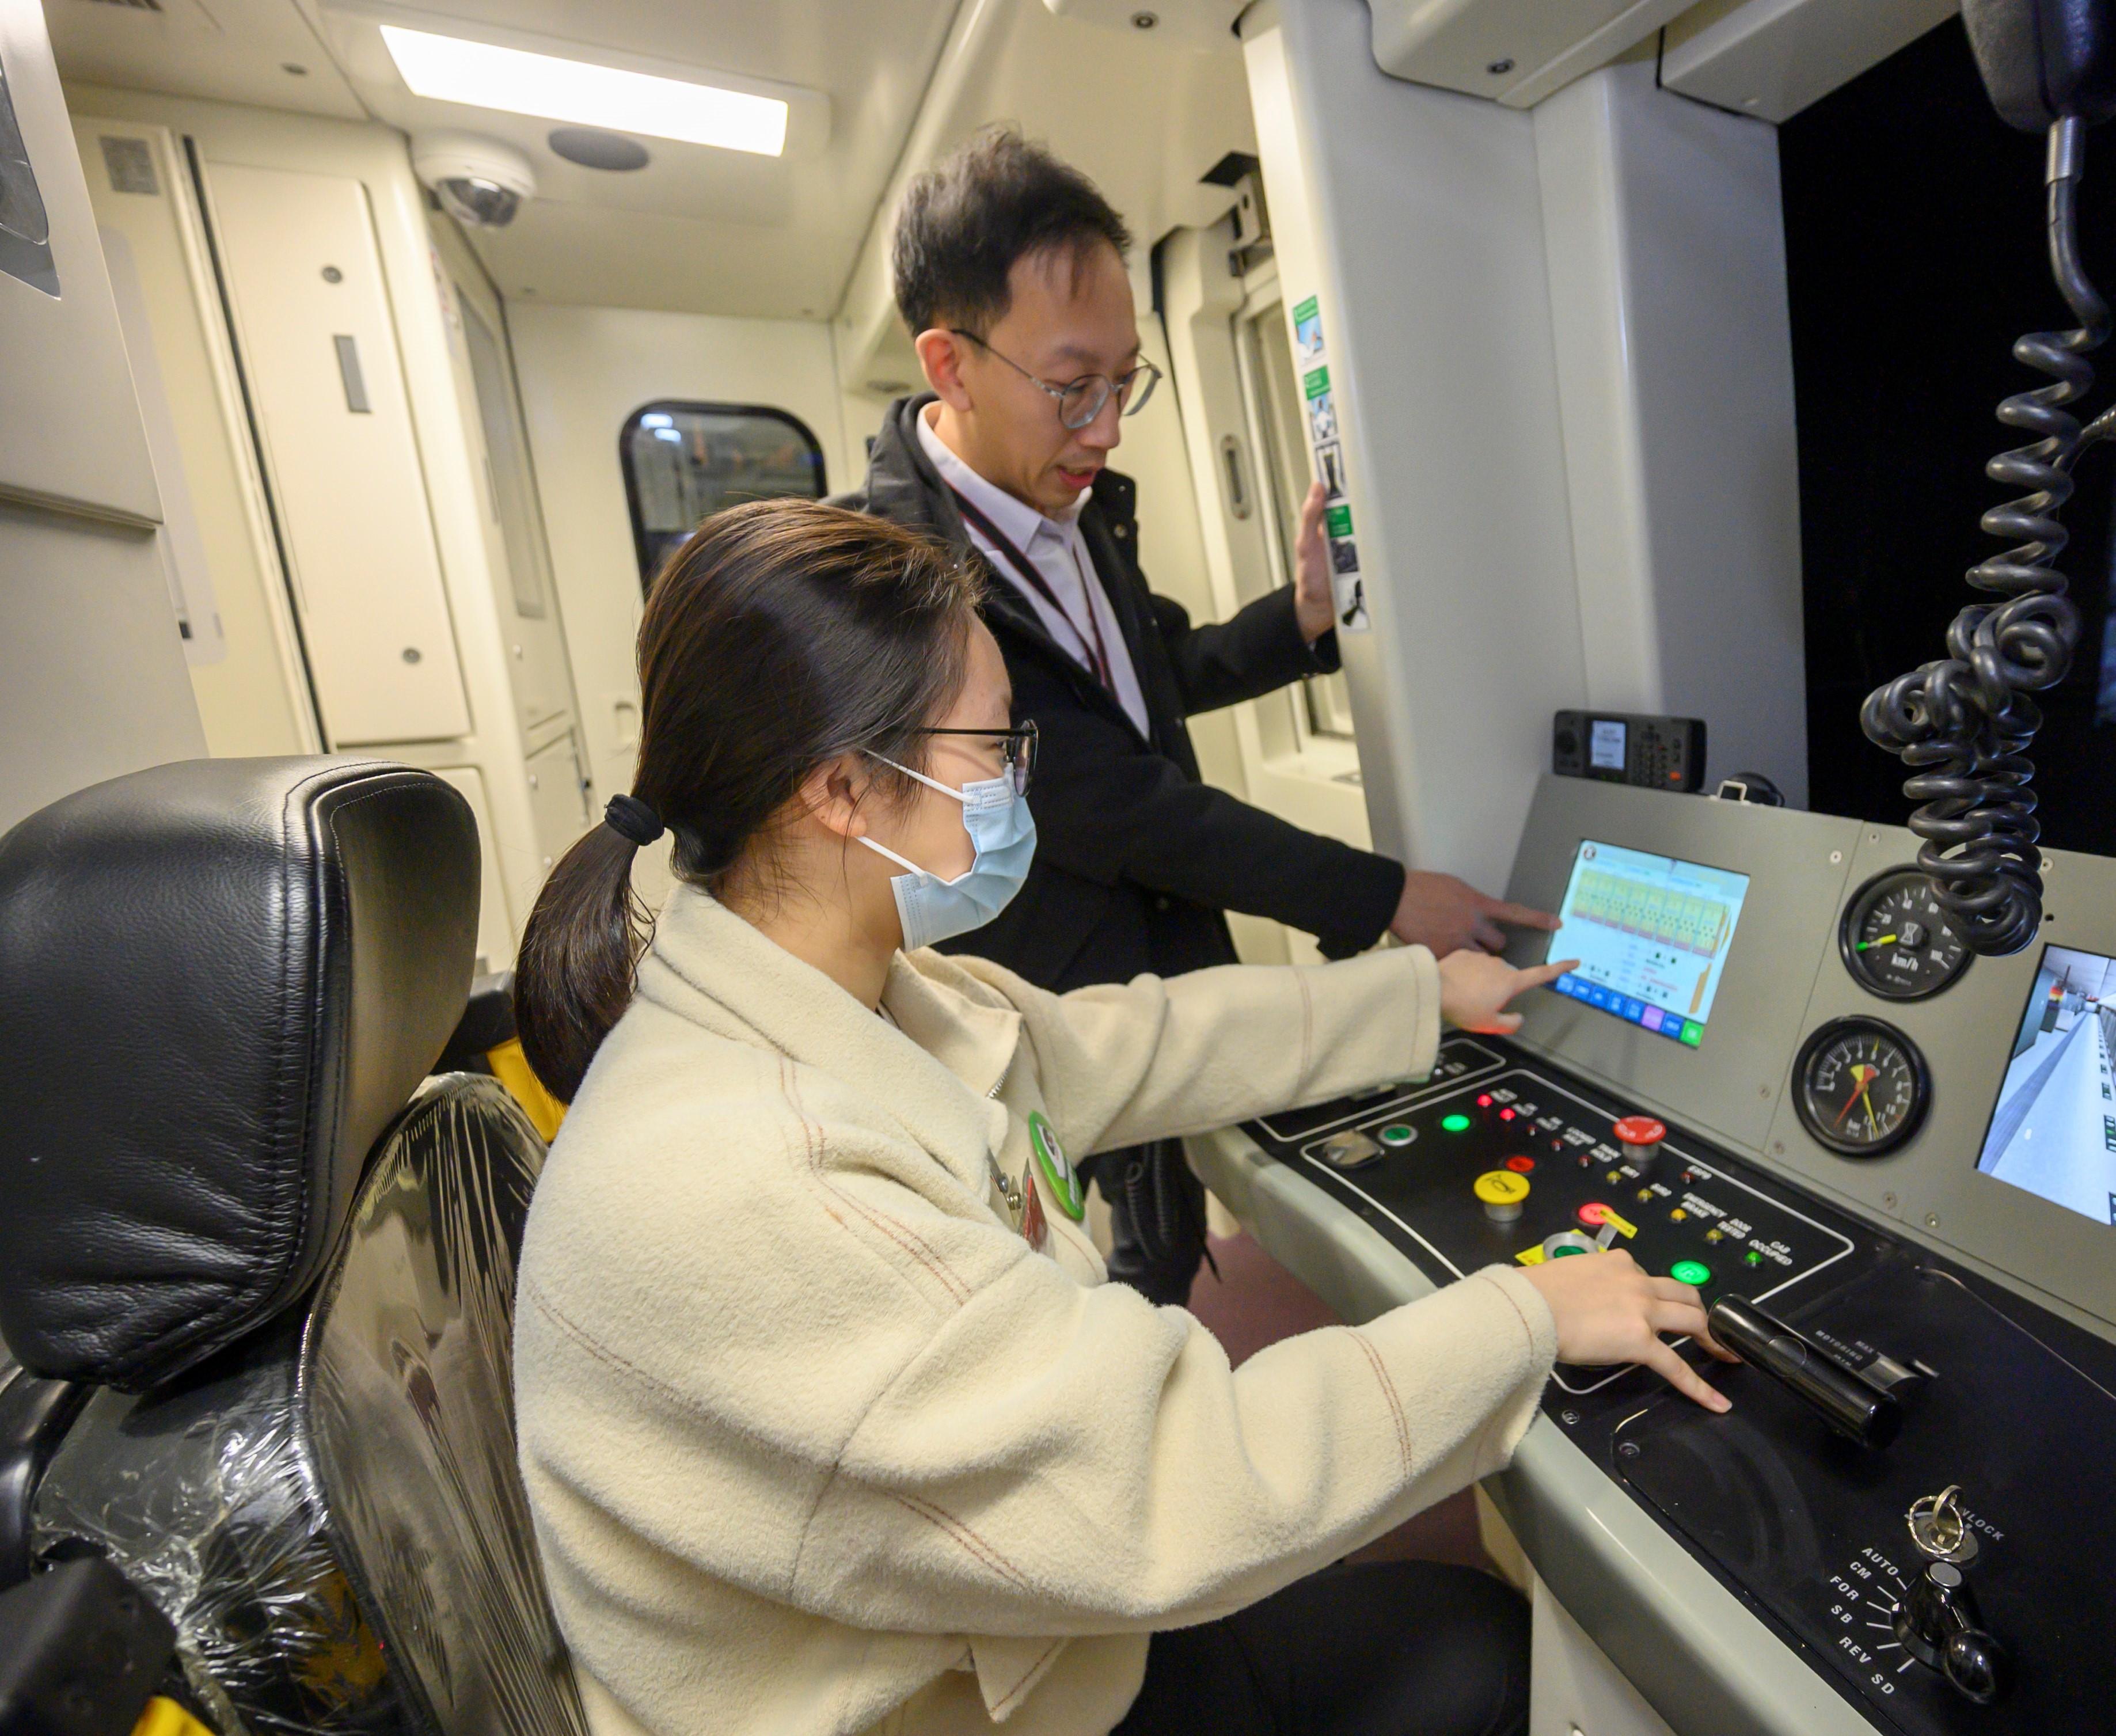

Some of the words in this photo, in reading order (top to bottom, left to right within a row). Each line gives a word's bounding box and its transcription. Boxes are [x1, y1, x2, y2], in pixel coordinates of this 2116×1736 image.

[1891, 952, 1919, 971] km/h
[1681, 1191, 1728, 1218] EMERGENCY
[1748, 1239, 1793, 1266] OCCUPIED
[1770, 1240, 1791, 1255] CAB
[1815, 1329, 1864, 1361] MOTORING
[1849, 1561, 1872, 1579] CM
[1861, 1547, 1899, 1576] AUTO
[1829, 1575, 1859, 1601] FOR
[1830, 1604, 1853, 1624] SB
[1838, 1636, 1872, 1664] REV
[1871, 1673, 1895, 1695] SD
